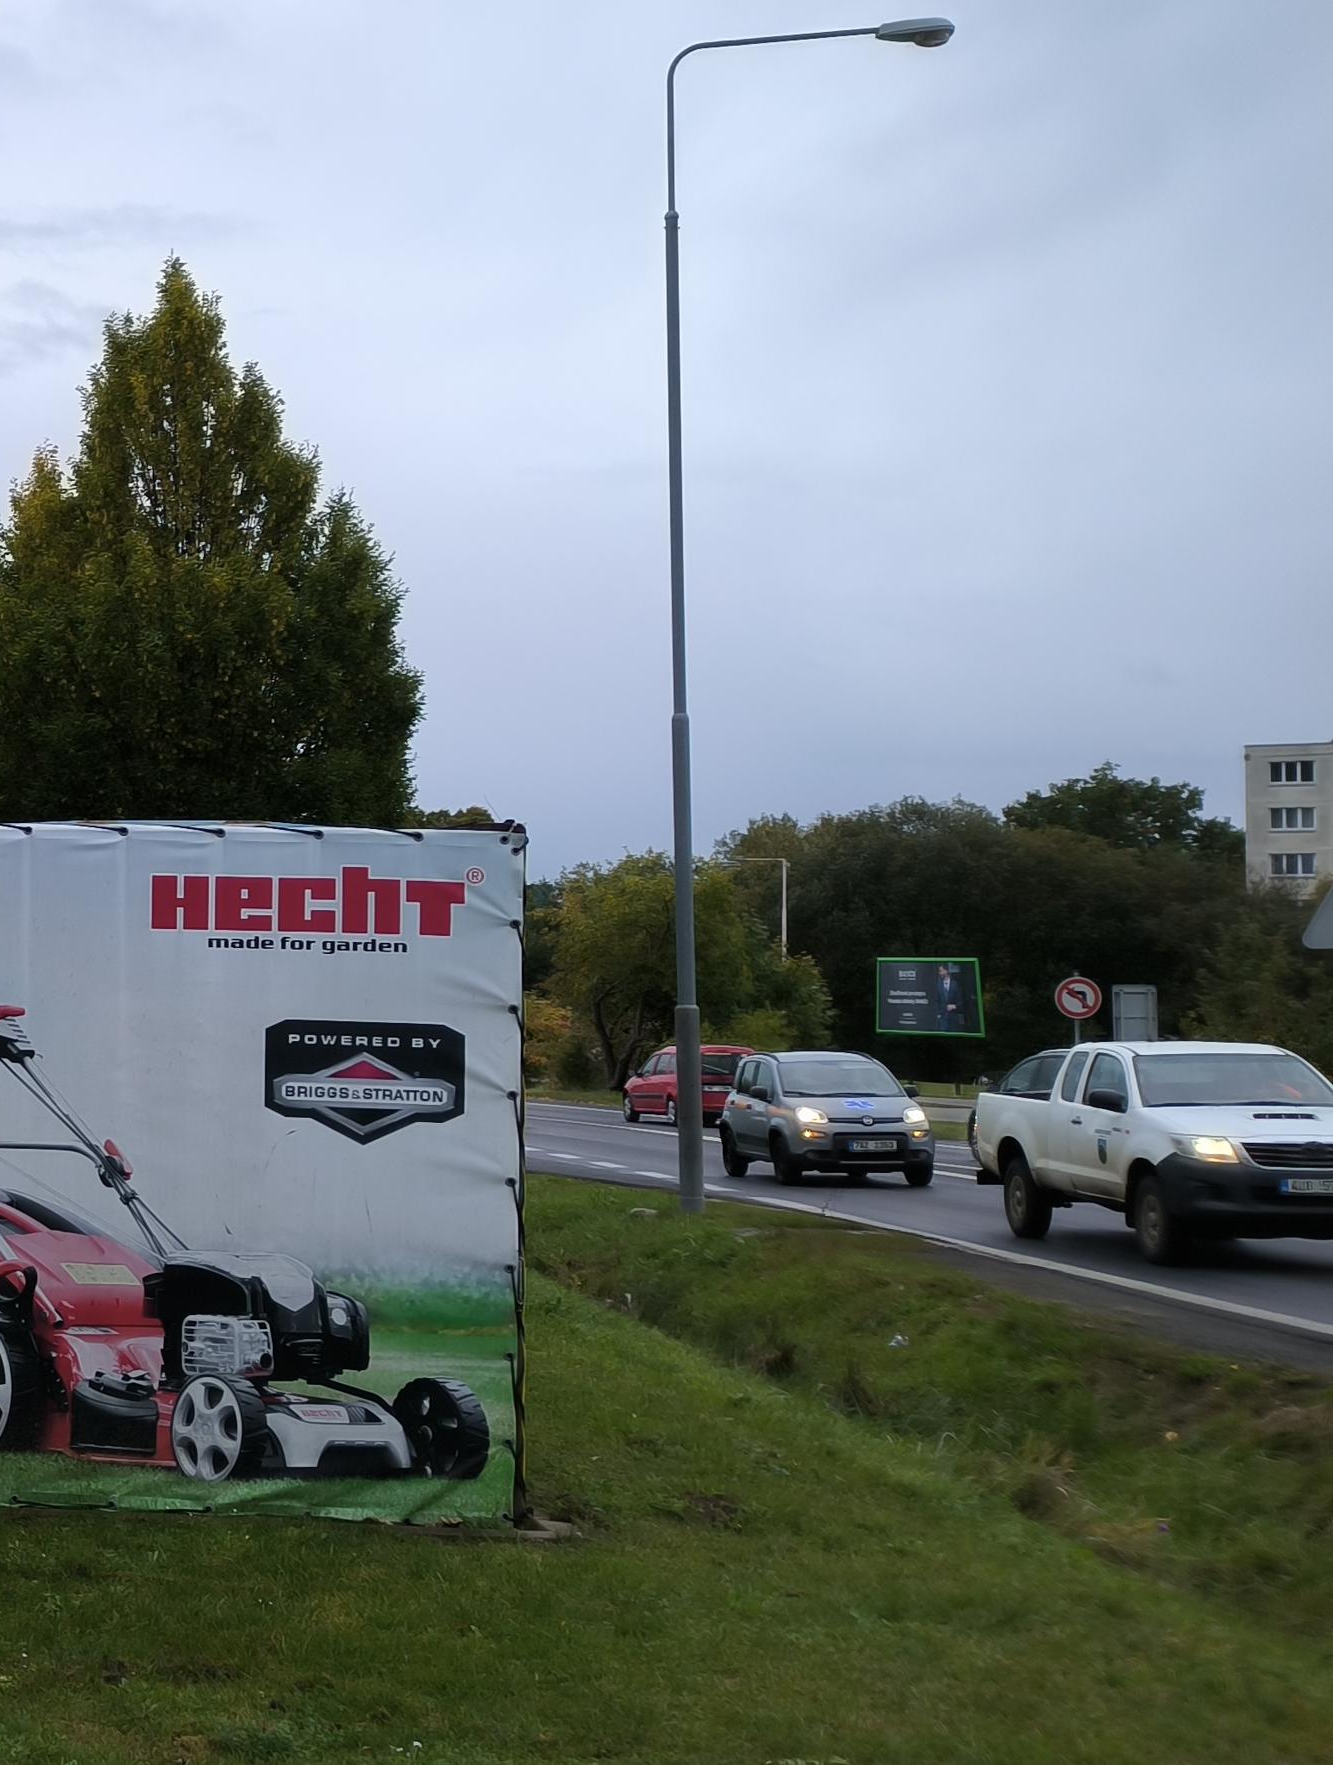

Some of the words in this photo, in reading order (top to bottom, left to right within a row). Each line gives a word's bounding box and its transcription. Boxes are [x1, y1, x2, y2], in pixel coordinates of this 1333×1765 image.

[207, 936, 275, 951] made
[280, 937, 316, 951] for
[322, 937, 408, 954] garden
[288, 1034, 400, 1047] POWERED
[412, 1038, 441, 1048] BY
